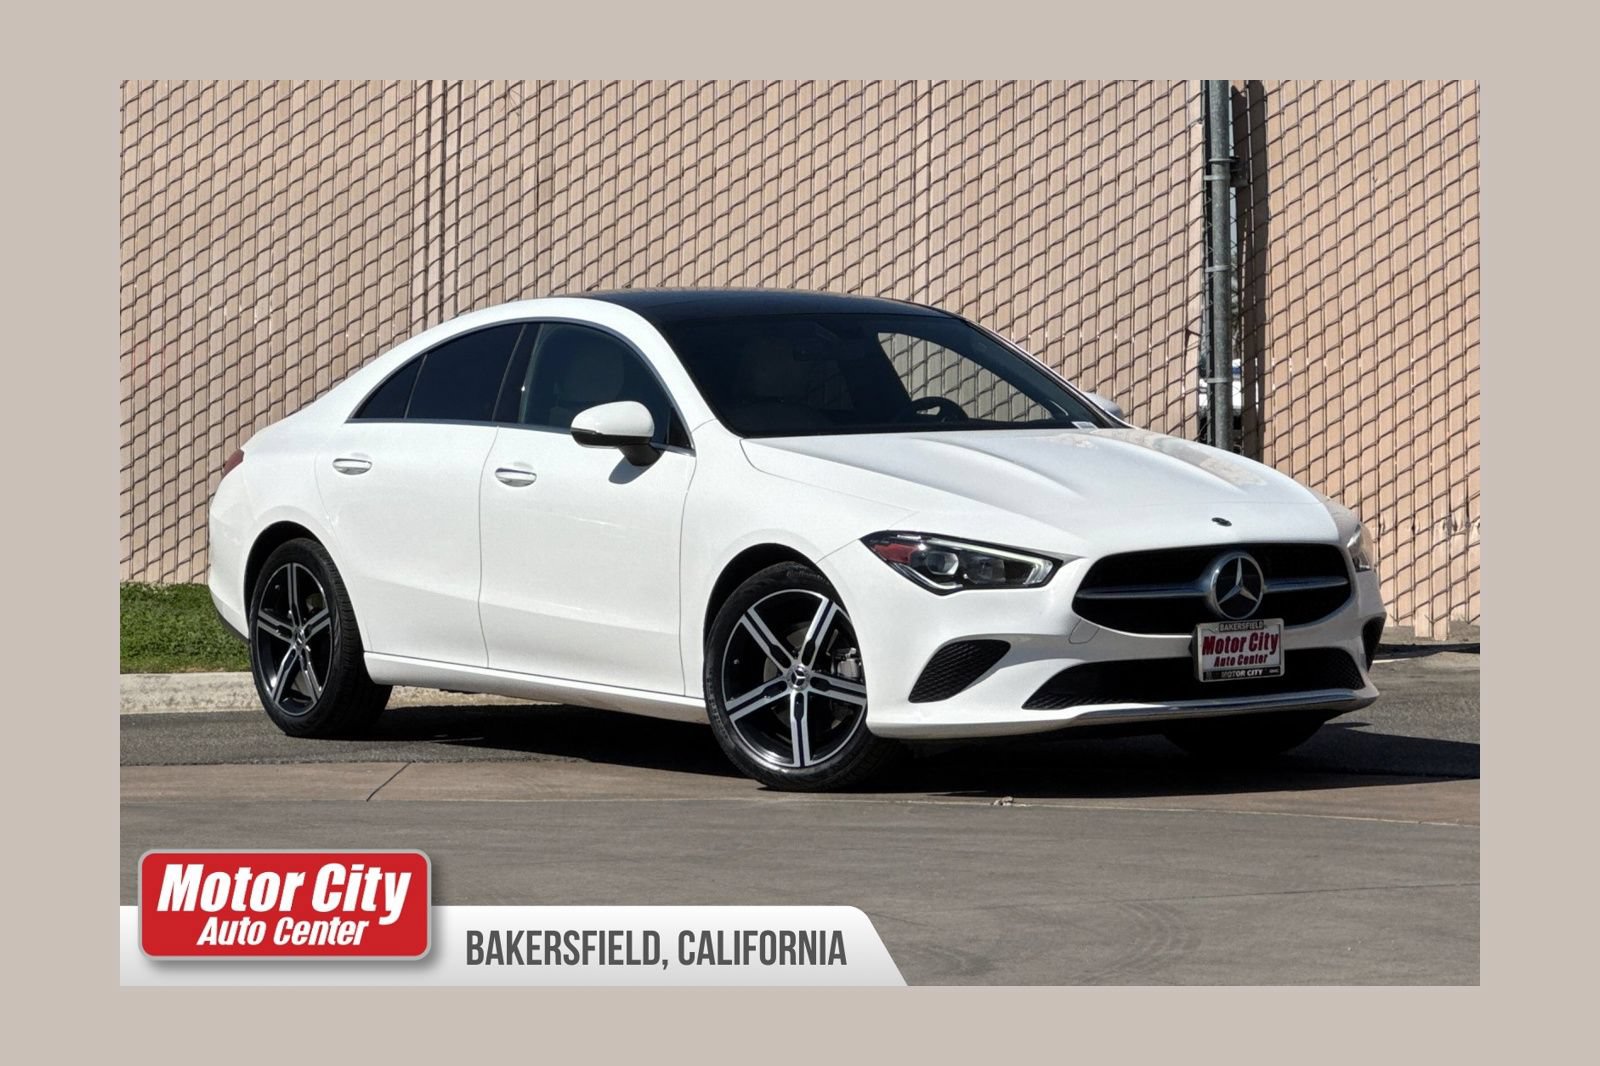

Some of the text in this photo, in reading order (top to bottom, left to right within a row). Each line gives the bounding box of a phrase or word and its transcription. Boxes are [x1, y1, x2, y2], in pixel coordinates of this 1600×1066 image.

[1220, 621, 1264, 631] BAKERSFIELD
[1202, 632, 1279, 655] Motor City
[1213, 654, 1268, 667] Auto Center
[1221, 670, 1245, 678] MOTOR
